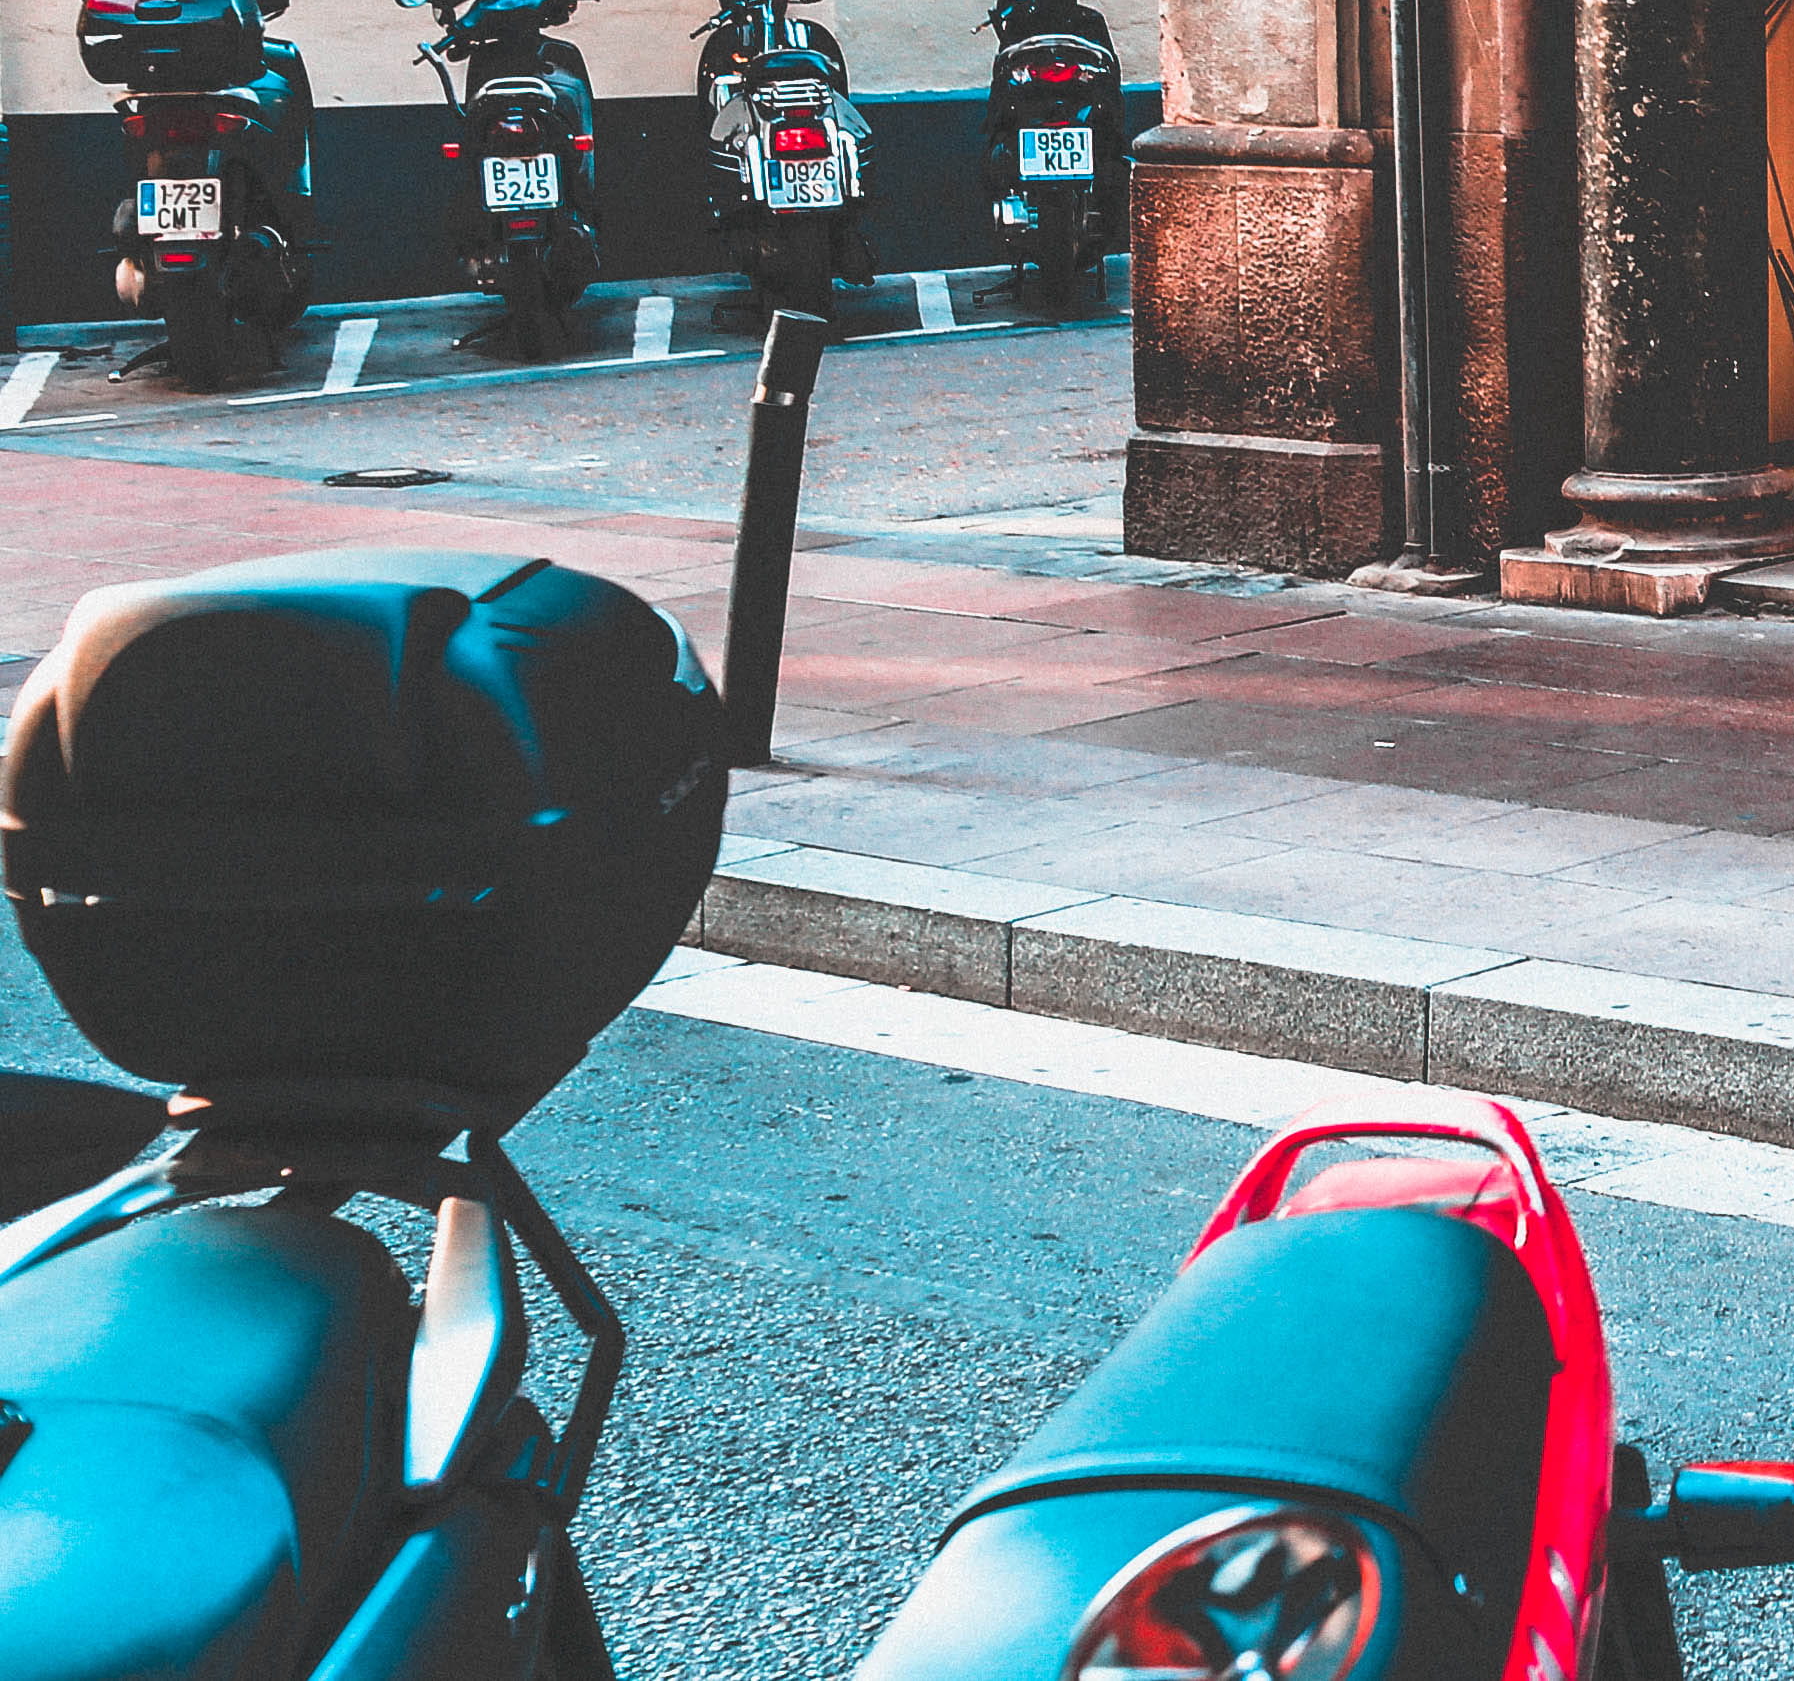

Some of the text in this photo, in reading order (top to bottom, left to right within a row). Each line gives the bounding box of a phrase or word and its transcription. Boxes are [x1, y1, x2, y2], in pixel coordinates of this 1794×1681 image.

[1037, 131, 1086, 151] 9561
[491, 158, 550, 181] B-TU
[1043, 150, 1083, 172] KLP
[784, 162, 837, 184] 0926
[494, 179, 550, 202] 5245
[786, 182, 826, 204] JSS
[157, 207, 201, 230] CMT
